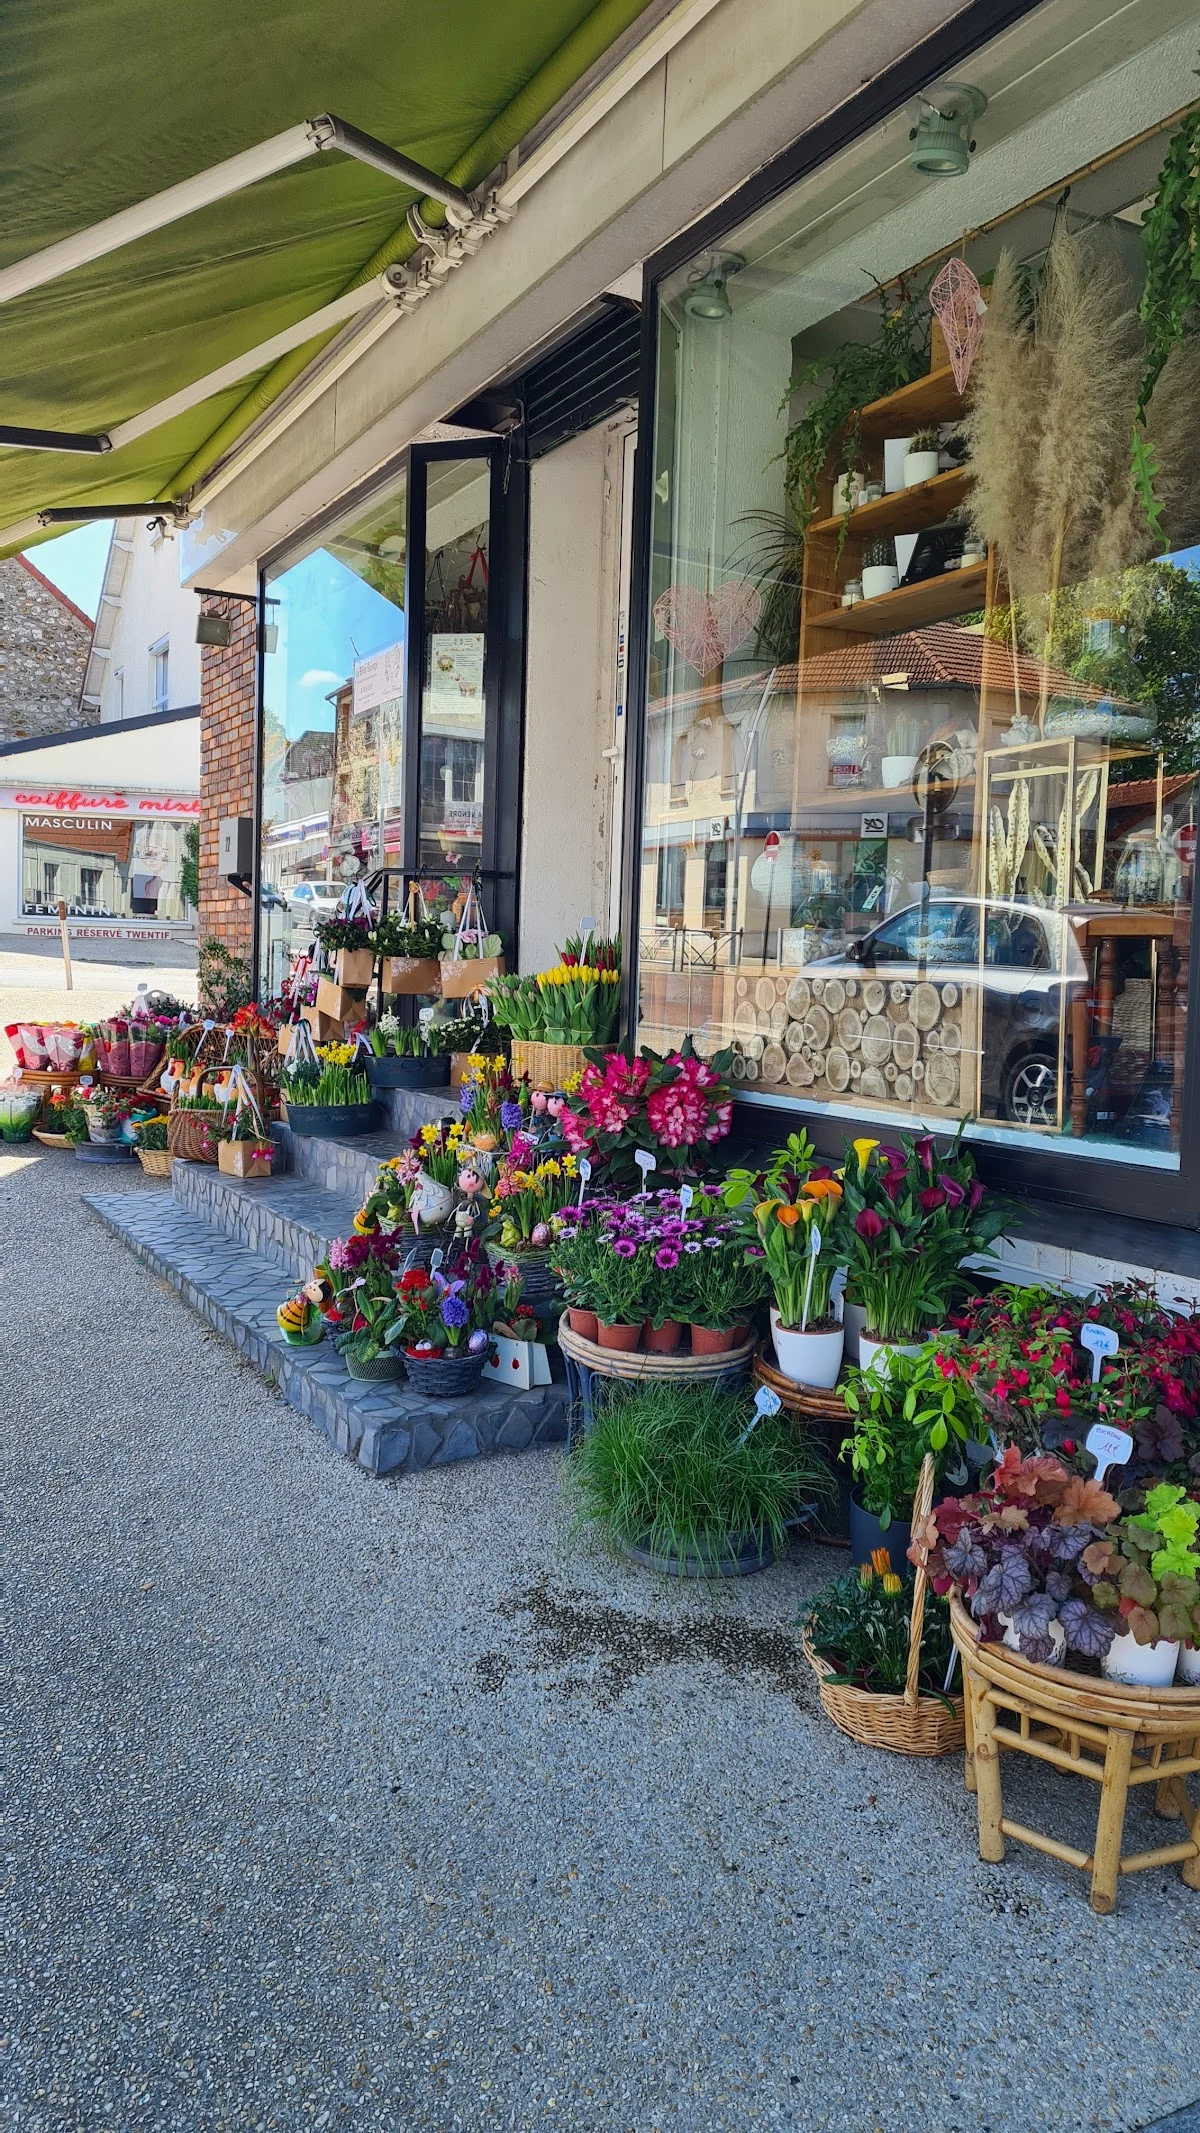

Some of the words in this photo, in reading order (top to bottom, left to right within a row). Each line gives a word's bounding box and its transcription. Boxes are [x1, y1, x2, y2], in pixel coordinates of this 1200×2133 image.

[15, 790, 129, 811] coiffure
[138, 798, 200, 813] mixt
[25, 816, 112, 831] MASCULIN
[126, 930, 170, 939] TWENTIF
